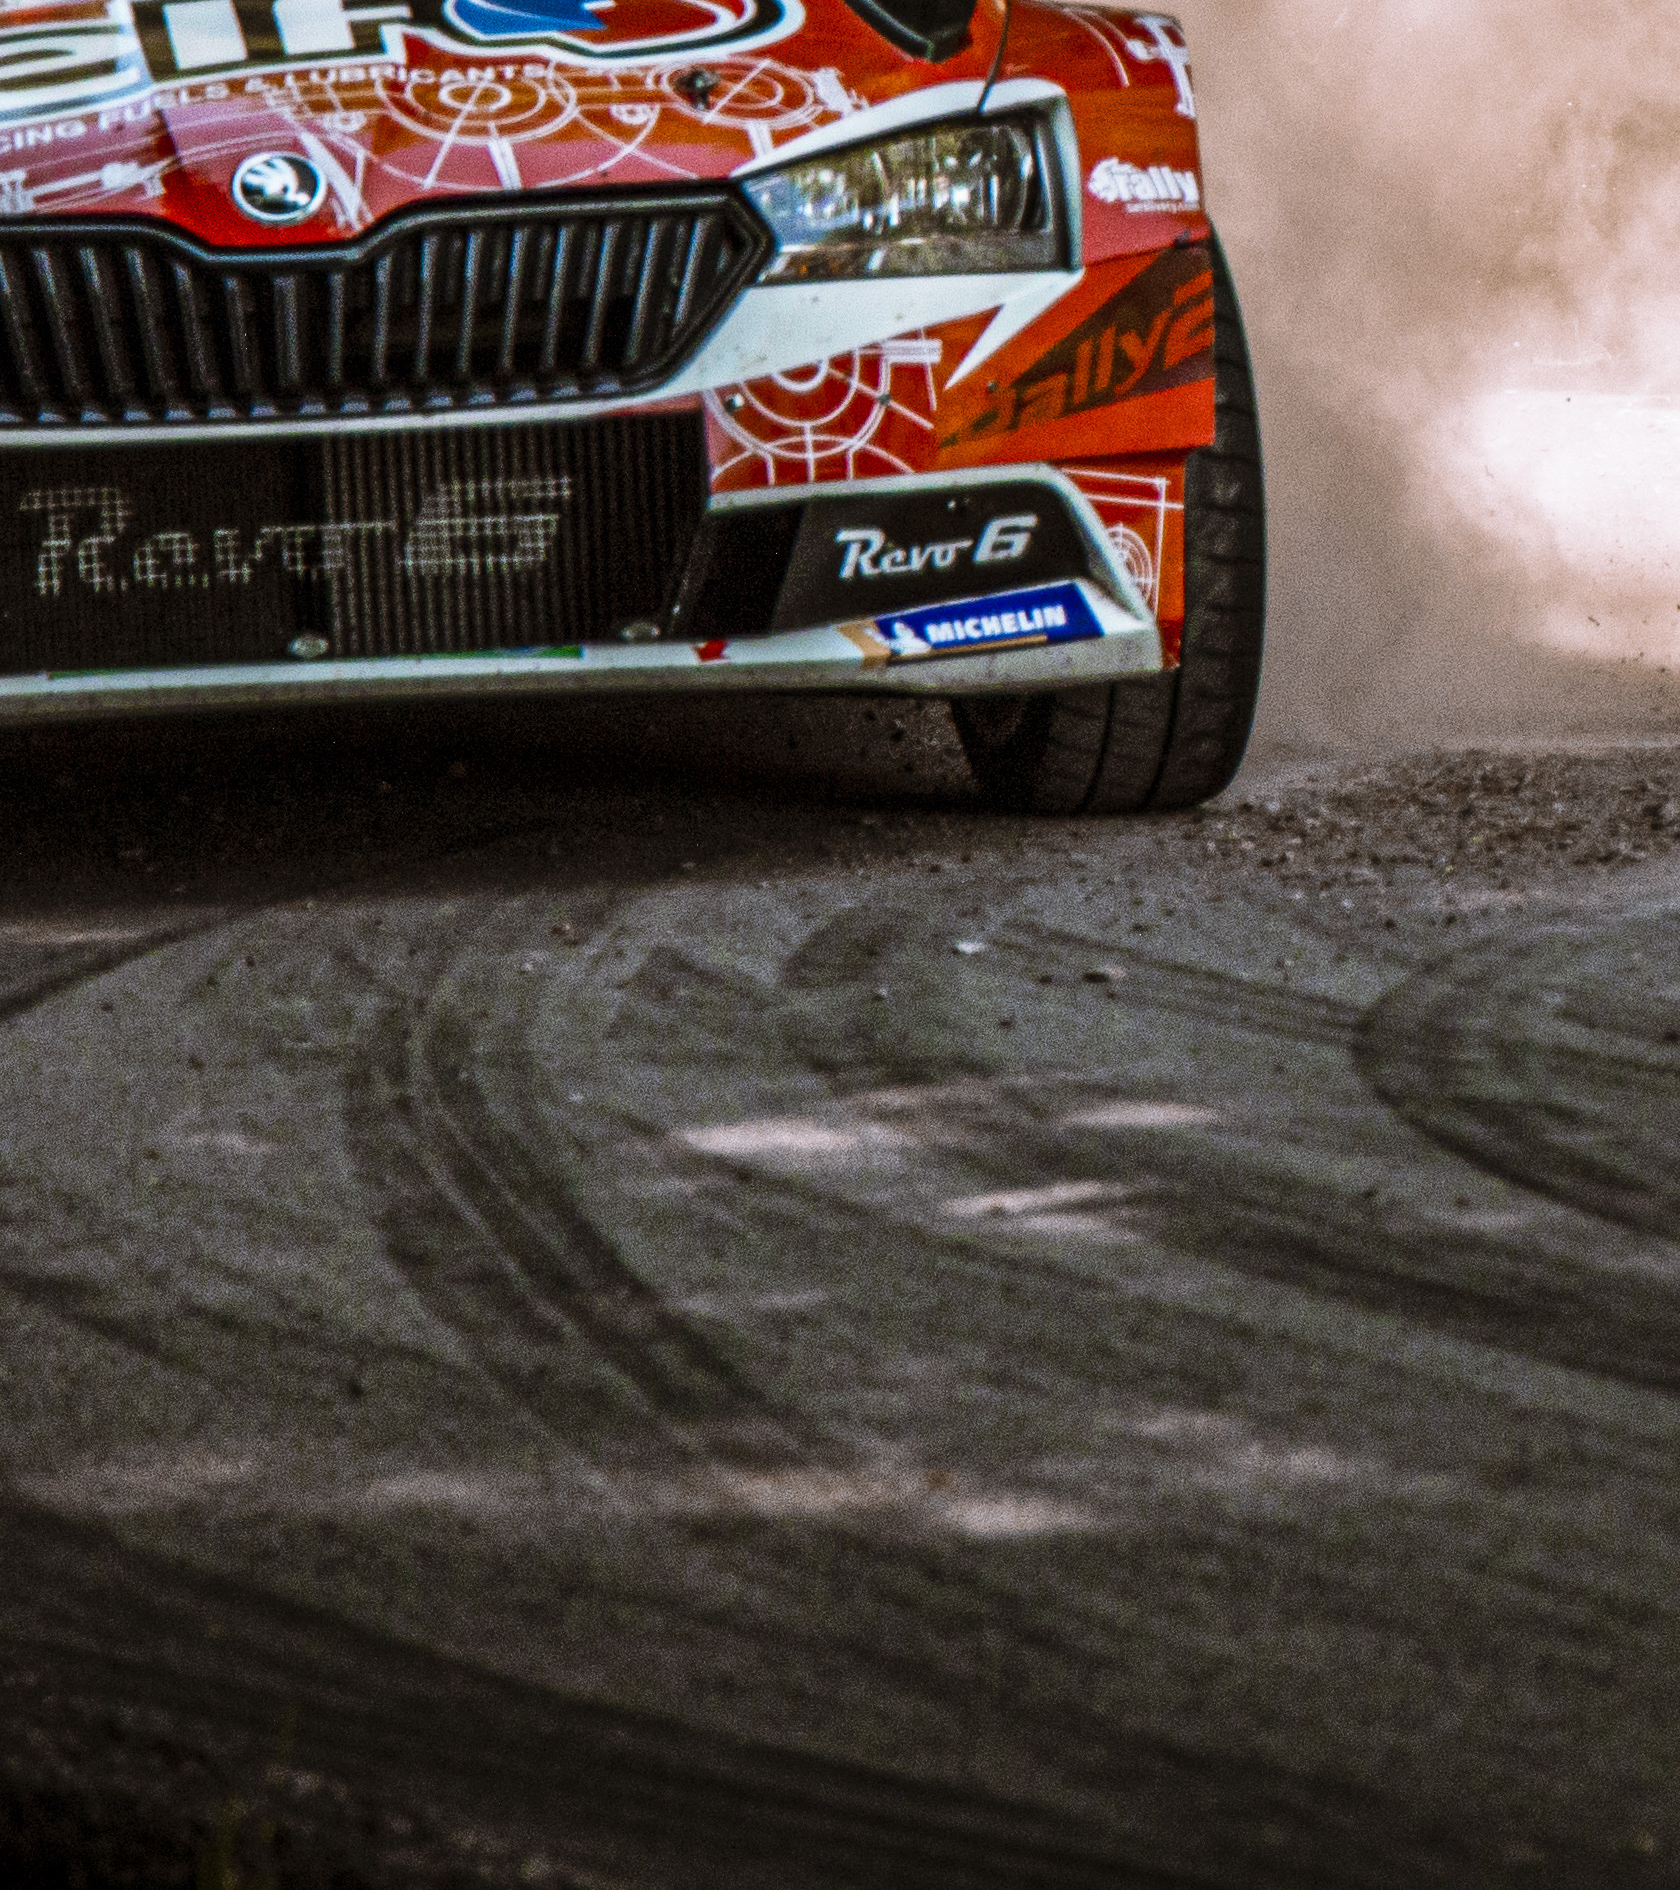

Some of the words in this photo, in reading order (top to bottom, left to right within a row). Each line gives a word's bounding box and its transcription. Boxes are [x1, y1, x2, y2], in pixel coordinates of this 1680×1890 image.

[98, 79, 228, 130] FUELS
[288, 62, 548, 96] LUBRICANTS
[835, 527, 974, 580] Revo
[974, 512, 1040, 563] 6
[925, 603, 1068, 645] MICHELIN
